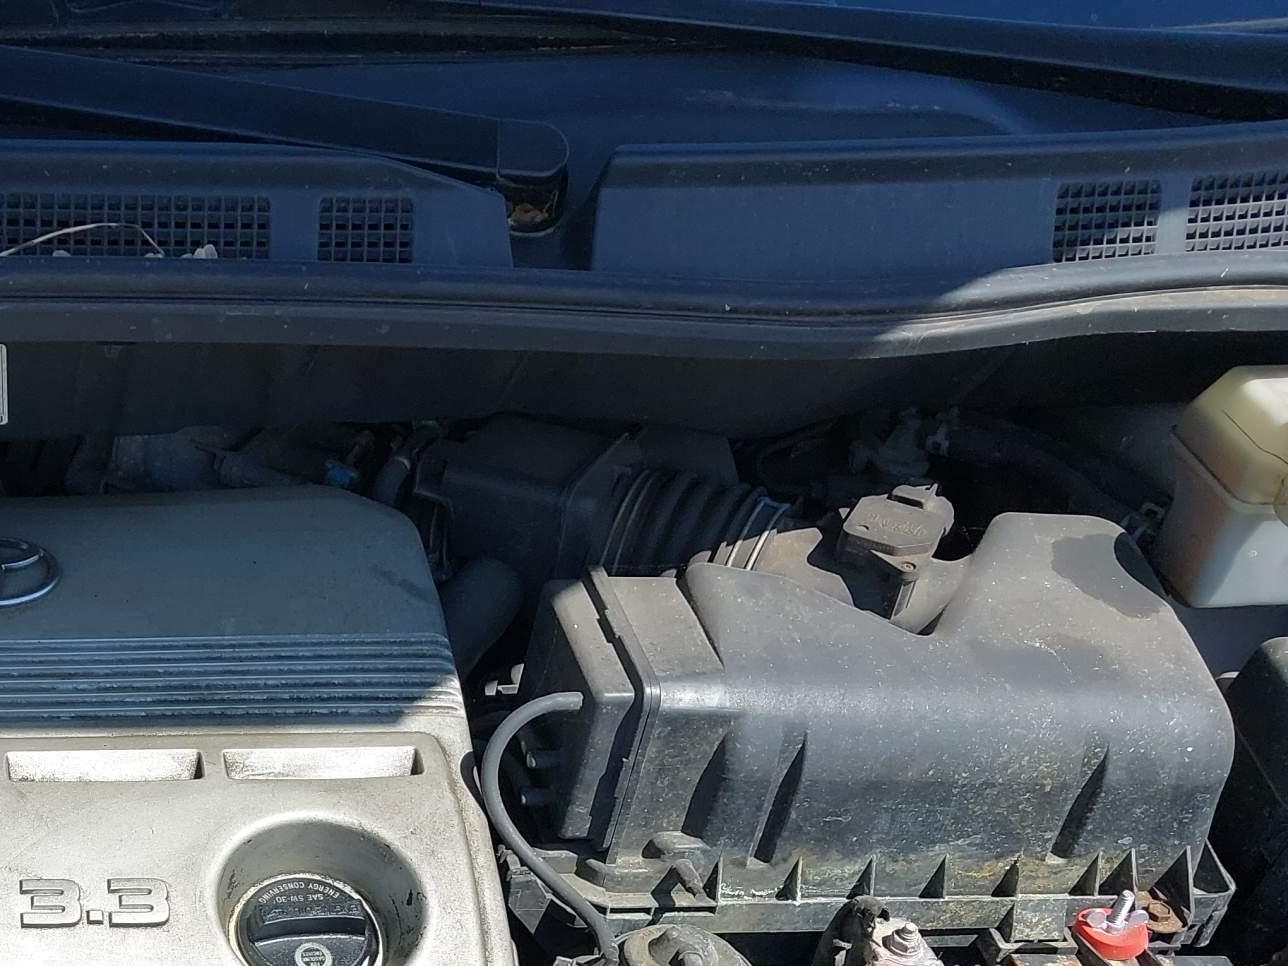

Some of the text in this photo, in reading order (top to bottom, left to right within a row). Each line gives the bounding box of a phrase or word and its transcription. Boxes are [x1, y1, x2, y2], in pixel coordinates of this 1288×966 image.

[18, 876, 171, 930] 3.3
[258, 881, 340, 904] ENERGY CONSERVING
[306, 893, 324, 901] SAE
